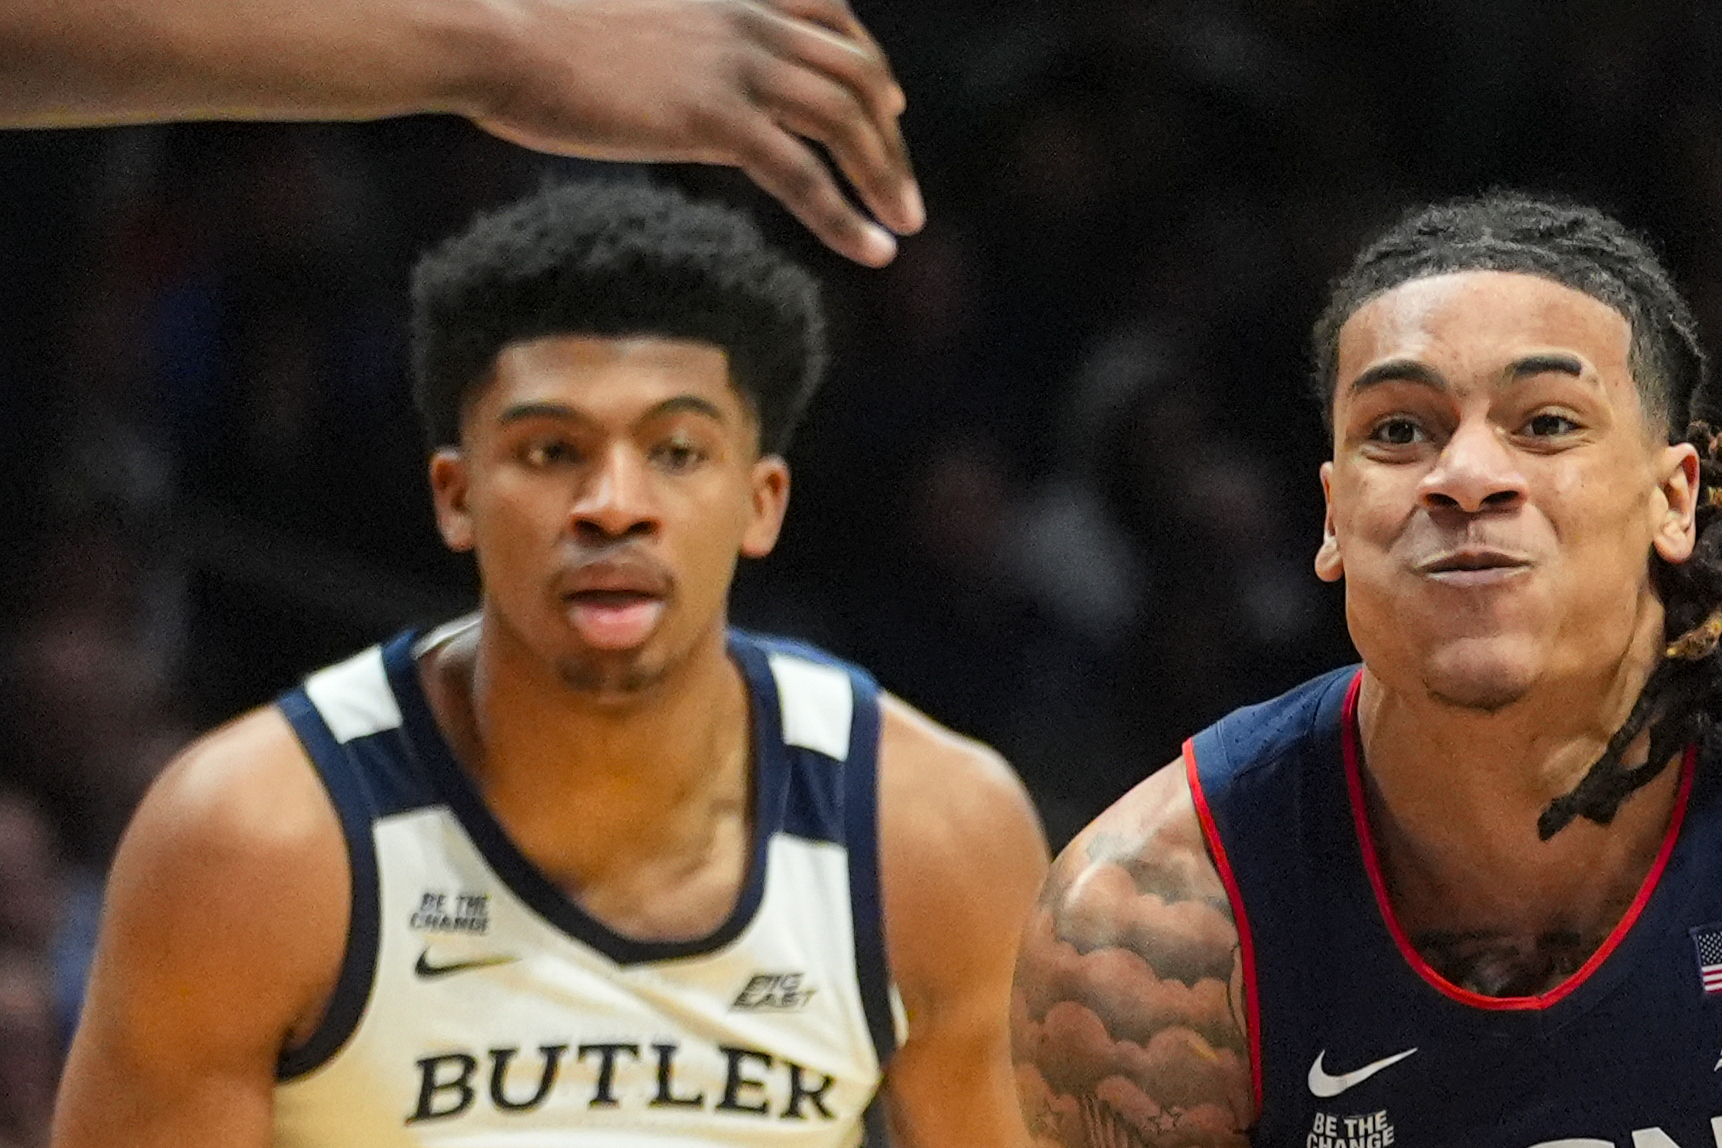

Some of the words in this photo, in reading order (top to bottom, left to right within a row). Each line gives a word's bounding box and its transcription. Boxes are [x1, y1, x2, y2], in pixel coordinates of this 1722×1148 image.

[405, 1043, 840, 1127] BUTLER
[1312, 1111, 1338, 1138] BE
[1343, 1108, 1389, 1139] THE
